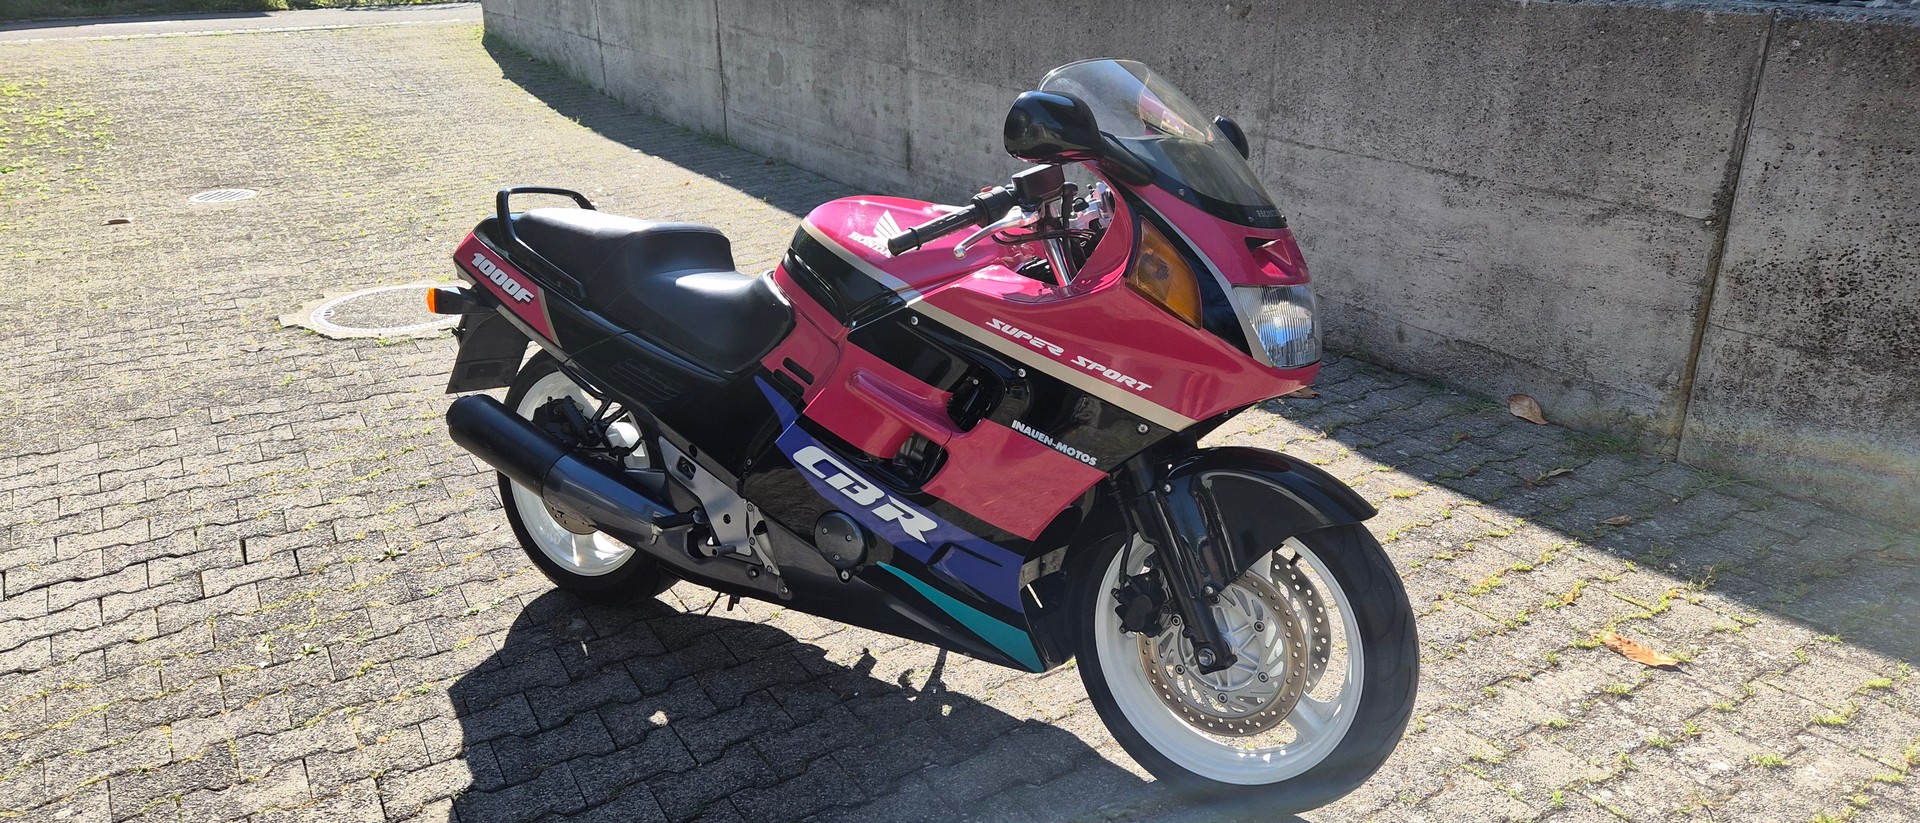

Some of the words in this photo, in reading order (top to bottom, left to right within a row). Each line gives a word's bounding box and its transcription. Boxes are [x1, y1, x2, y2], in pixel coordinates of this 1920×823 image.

[471, 253, 535, 303] 1000F
[985, 318, 1065, 357] SUPER
[1071, 355, 1153, 392] SPORT
[1011, 420, 1098, 466] INAUEN-MOTOS
[793, 446, 938, 544] CBR
